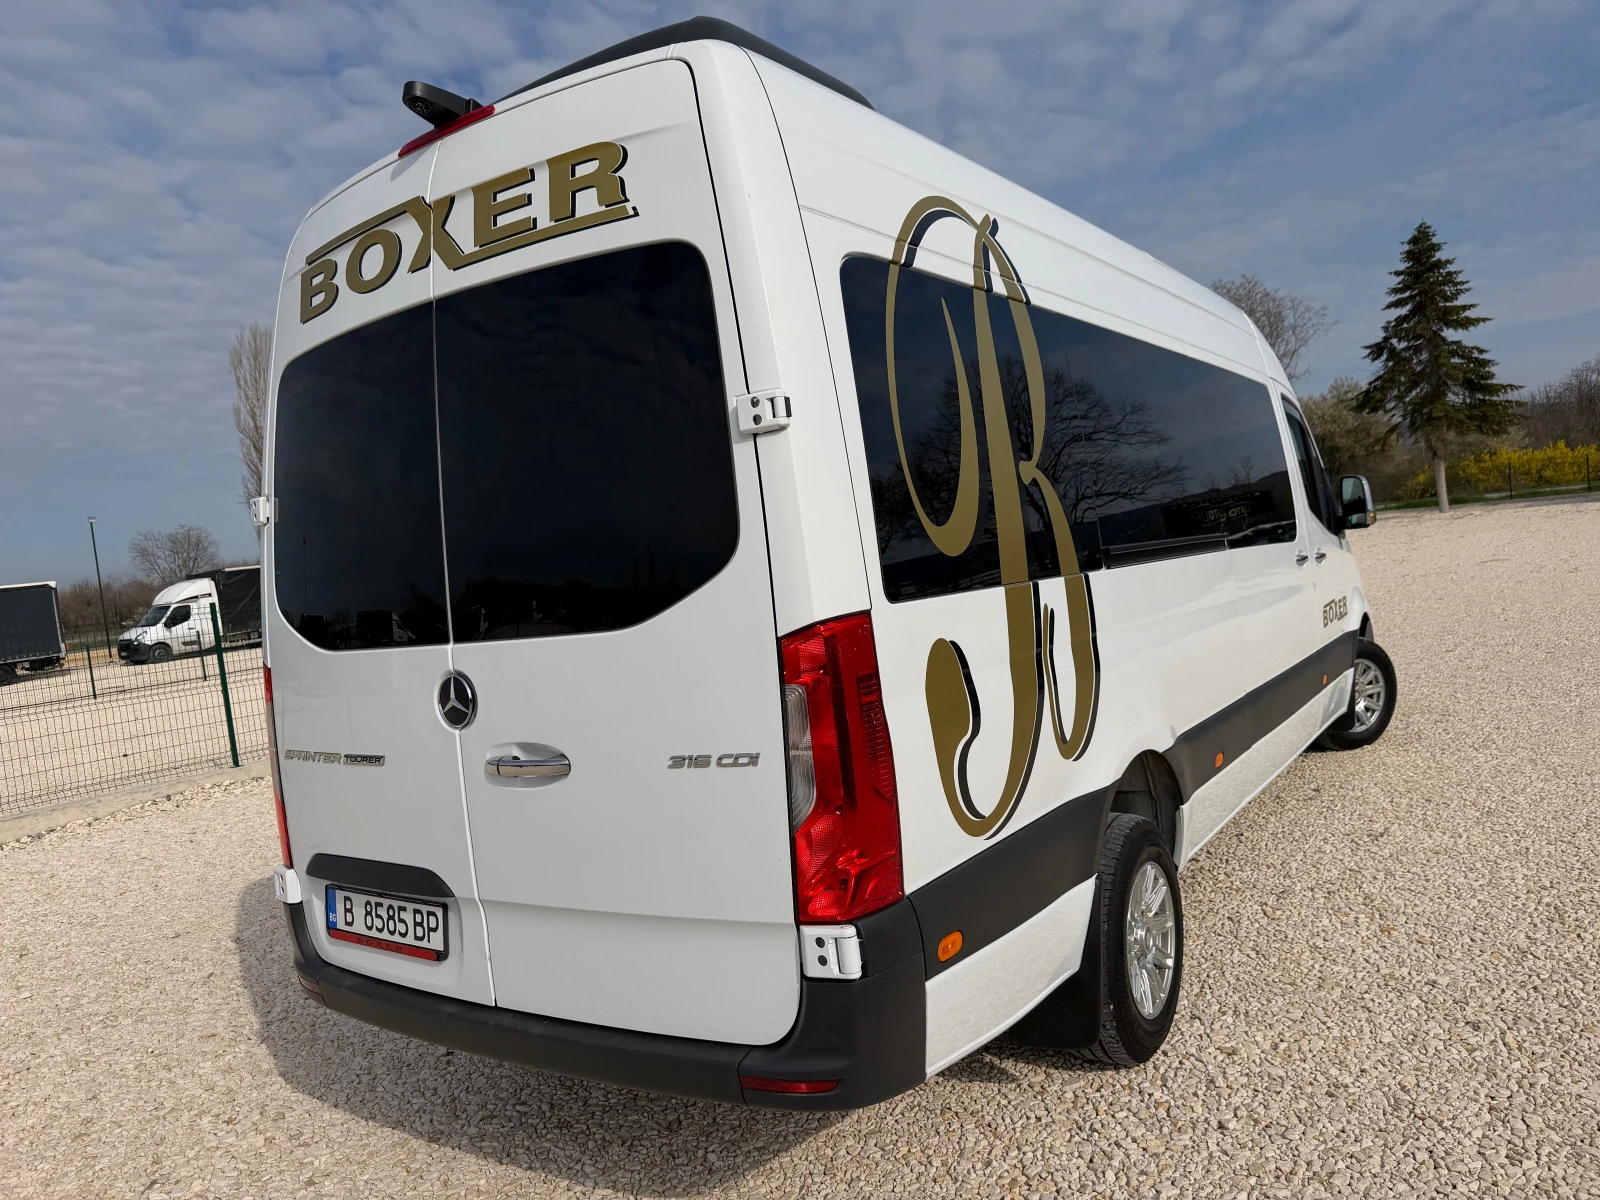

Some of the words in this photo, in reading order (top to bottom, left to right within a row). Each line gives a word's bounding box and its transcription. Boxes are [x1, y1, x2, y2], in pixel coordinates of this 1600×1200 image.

[300, 141, 639, 324] BOXER
[1322, 595, 1348, 629] BOXER
[284, 749, 342, 765] SPRINTER
[667, 754, 712, 769] 316
[716, 752, 761, 767] CDI
[329, 912, 337, 922] BG
[343, 895, 355, 927] B
[364, 899, 409, 939] 8585
[412, 908, 440, 943] BP
[357, 937, 403, 953] BOXER
